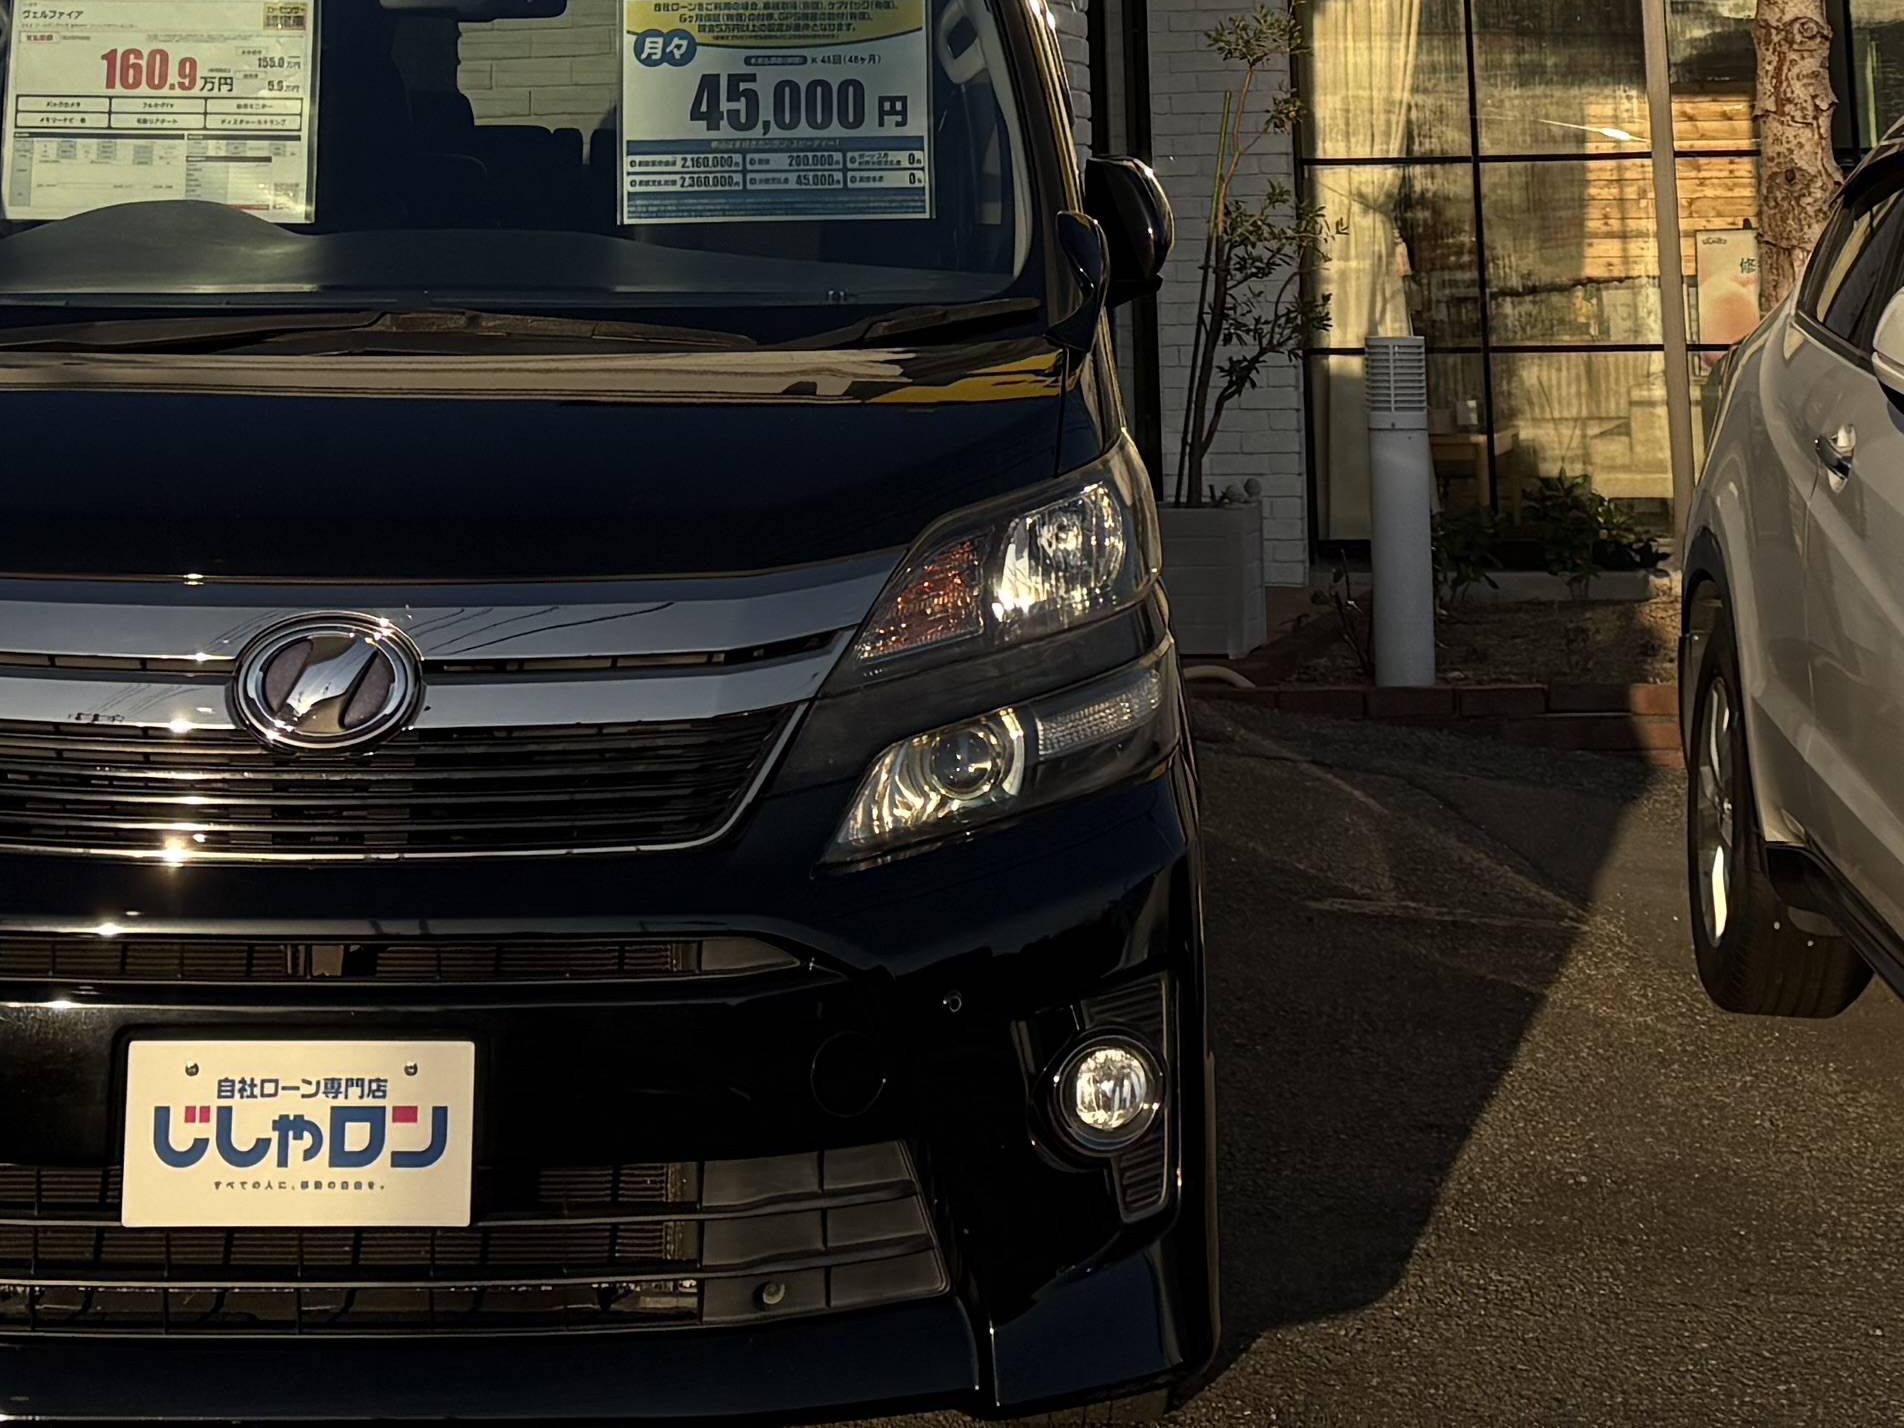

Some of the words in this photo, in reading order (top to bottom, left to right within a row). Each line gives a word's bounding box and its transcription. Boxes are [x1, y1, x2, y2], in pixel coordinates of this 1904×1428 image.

[22, 10, 84, 20] ヴェルファイア
[640, 37, 689, 60] 月々
[217, 1077, 388, 1099] 自社ローン専門店
[153, 1105, 448, 1168] じしゃロン
